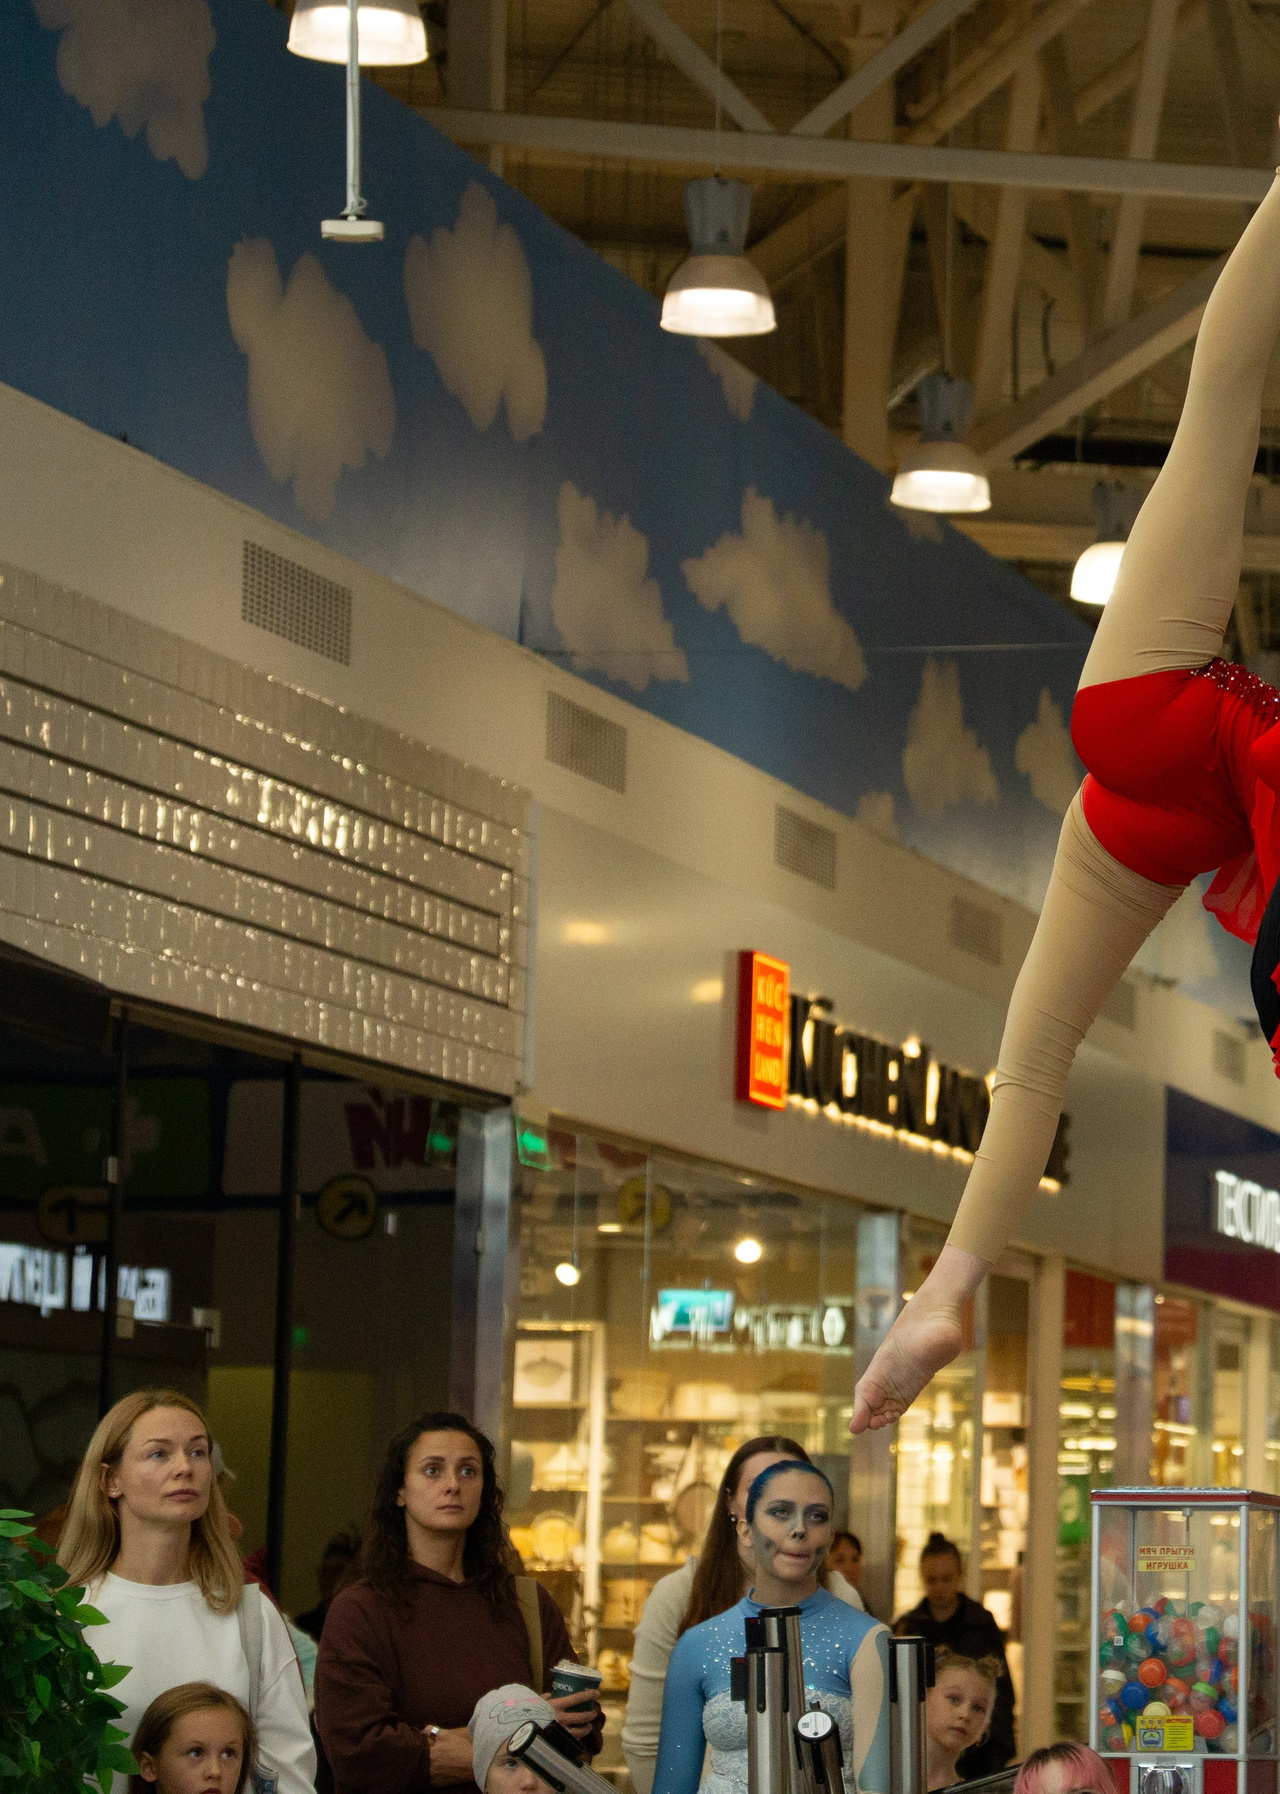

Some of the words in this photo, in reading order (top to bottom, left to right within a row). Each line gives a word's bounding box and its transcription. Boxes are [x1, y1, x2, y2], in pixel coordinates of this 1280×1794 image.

[1139, 1547, 1157, 1556] МЯЧ
[1160, 1547, 1194, 1556] ПРЫГУН
[1146, 1561, 1188, 1570] ИГРУШКА
